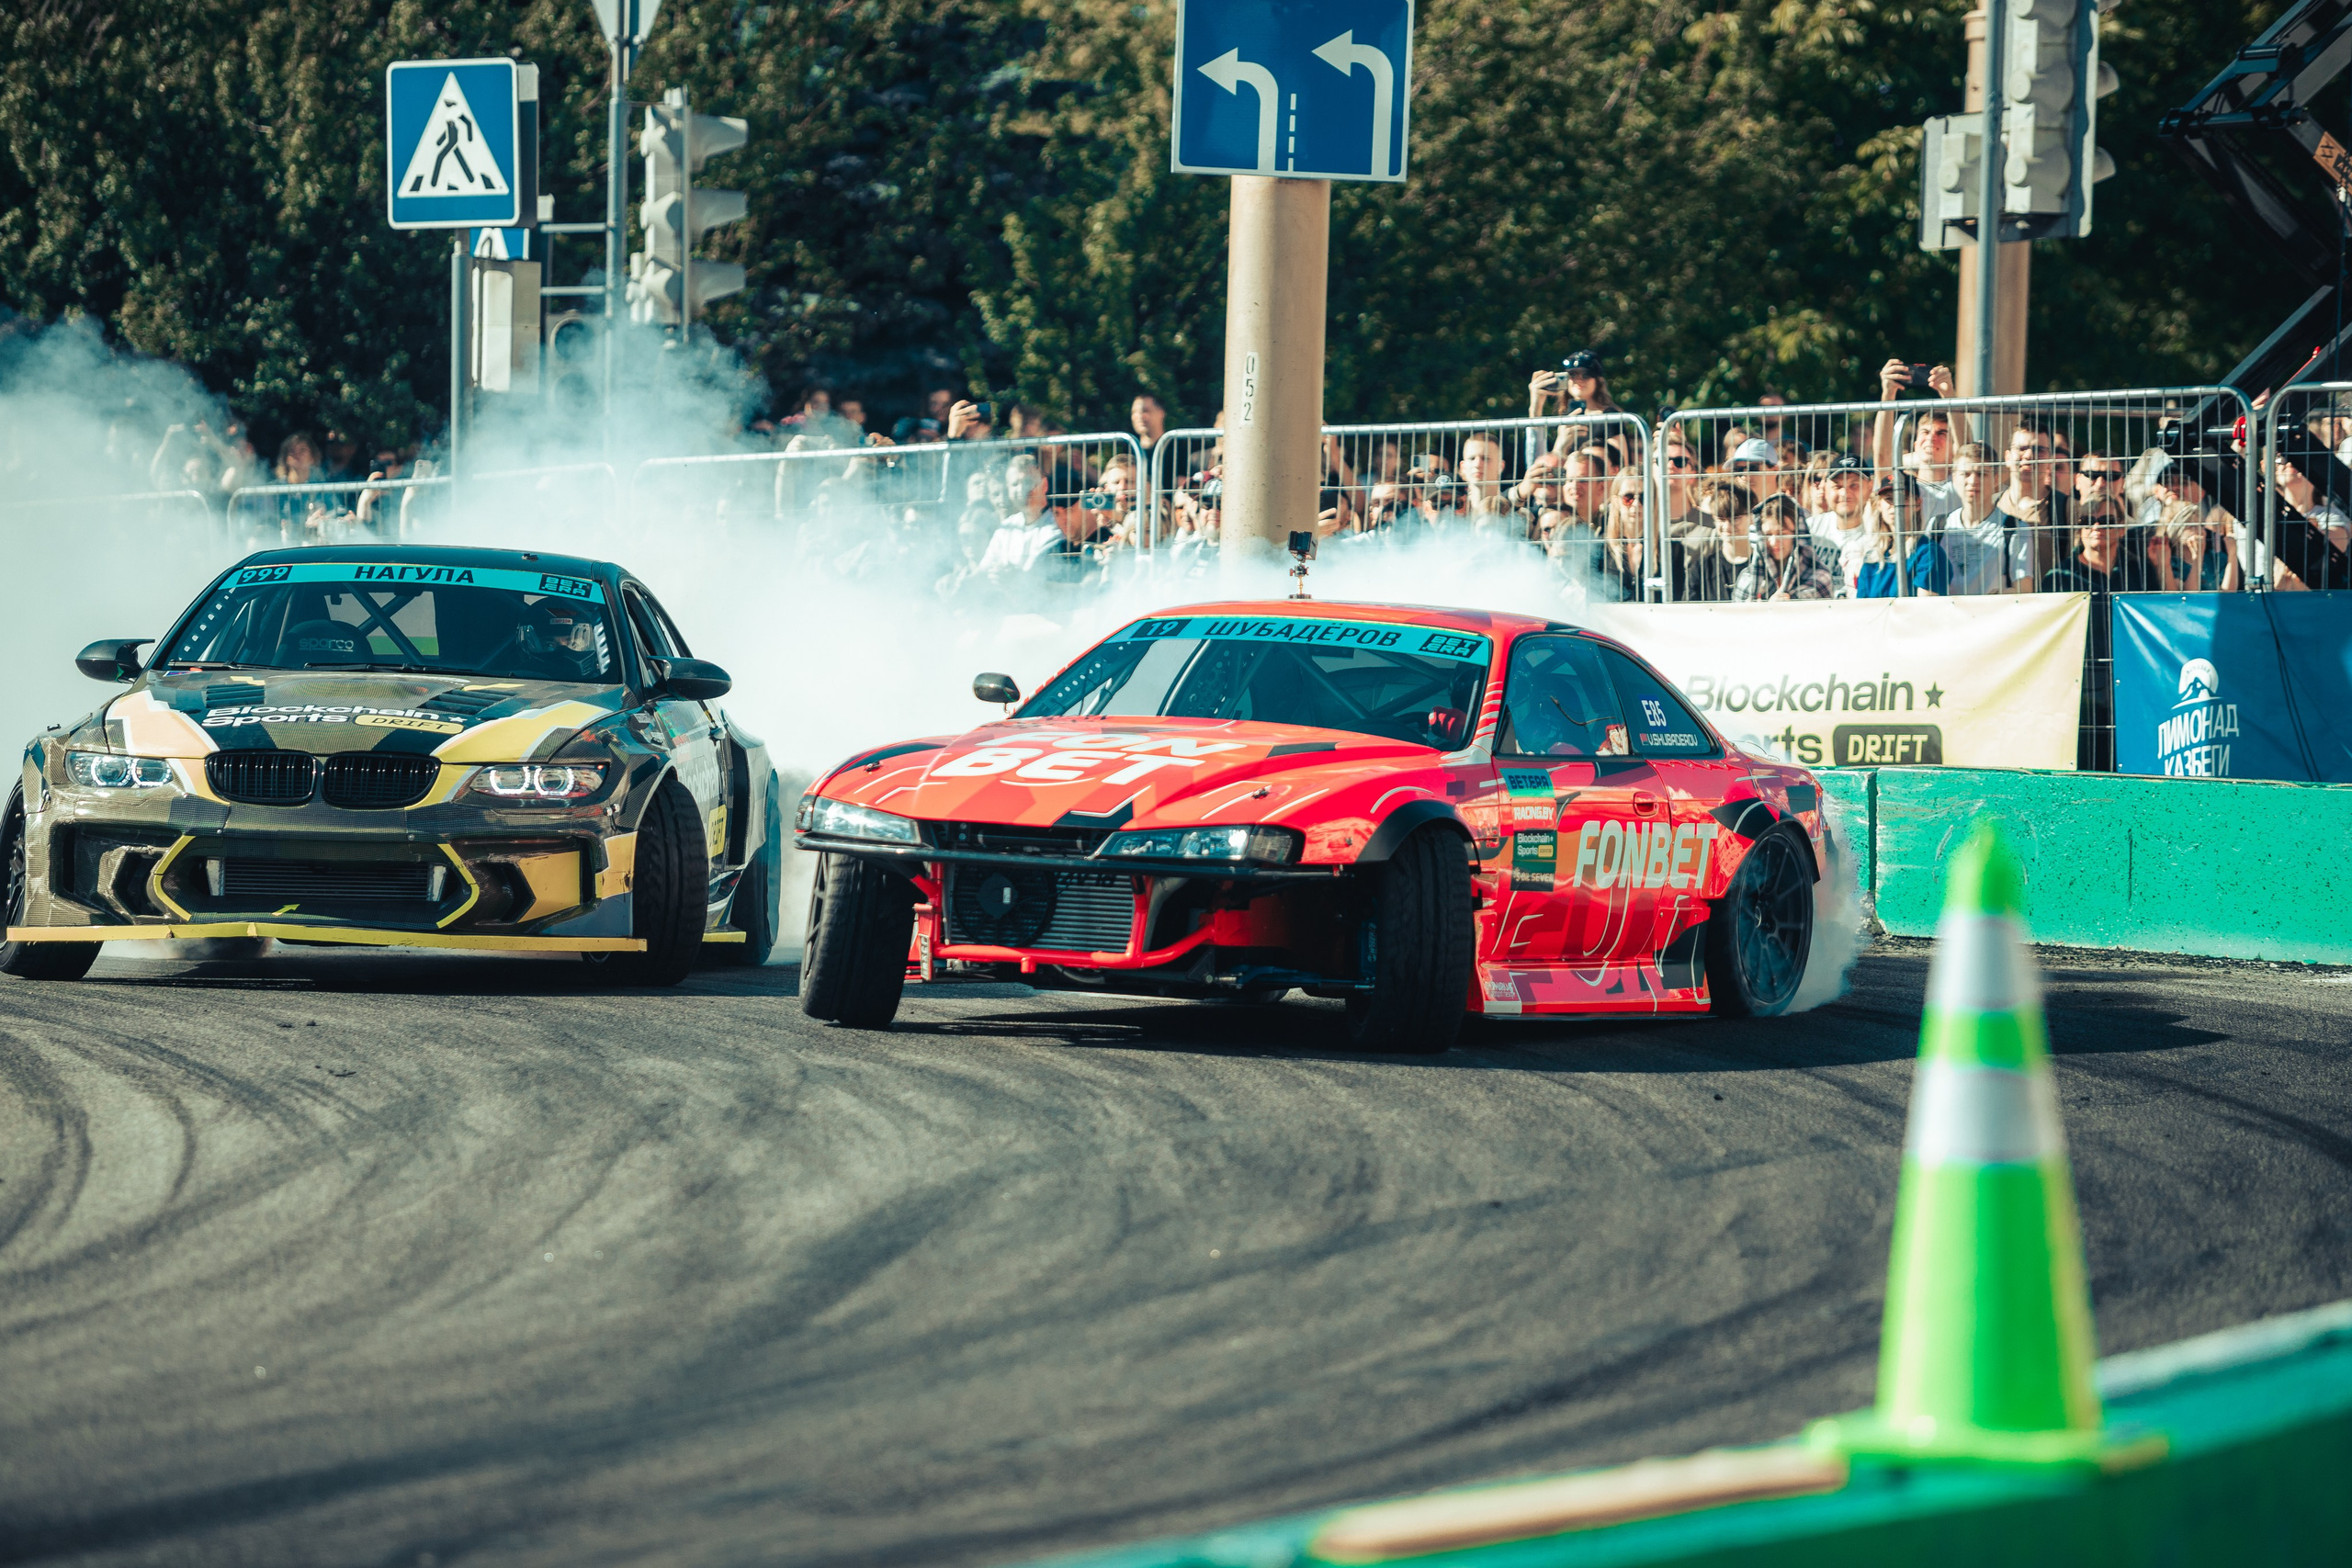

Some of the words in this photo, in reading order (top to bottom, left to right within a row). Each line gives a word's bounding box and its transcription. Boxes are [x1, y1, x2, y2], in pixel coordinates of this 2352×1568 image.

[1243, 355, 1255, 422] 052
[242, 568, 288, 583] 999
[354, 566, 475, 584] НАГУЛА
[546, 576, 588, 589] BET
[1147, 621, 1179, 636] 19
[1204, 620, 1402, 648] ШУБАДЁРОВ
[1430, 635, 1477, 649] BET
[1685, 671, 1914, 713] Blockchain
[200, 713, 349, 728] Sports
[370, 716, 452, 731] DRIFT
[206, 705, 441, 721] Blockchain
[1641, 699, 1668, 728] E85
[975, 731, 1248, 757] FON
[1743, 724, 1824, 764] rts
[1847, 734, 1928, 763] DRIFT
[2157, 704, 2240, 760] ЛИМОНАД
[930, 748, 1205, 785] BET
[2164, 744, 2231, 777] КАЗБЕГИ
[1517, 832, 1550, 843] Blockchain
[1572, 819, 1718, 889] FONBET
